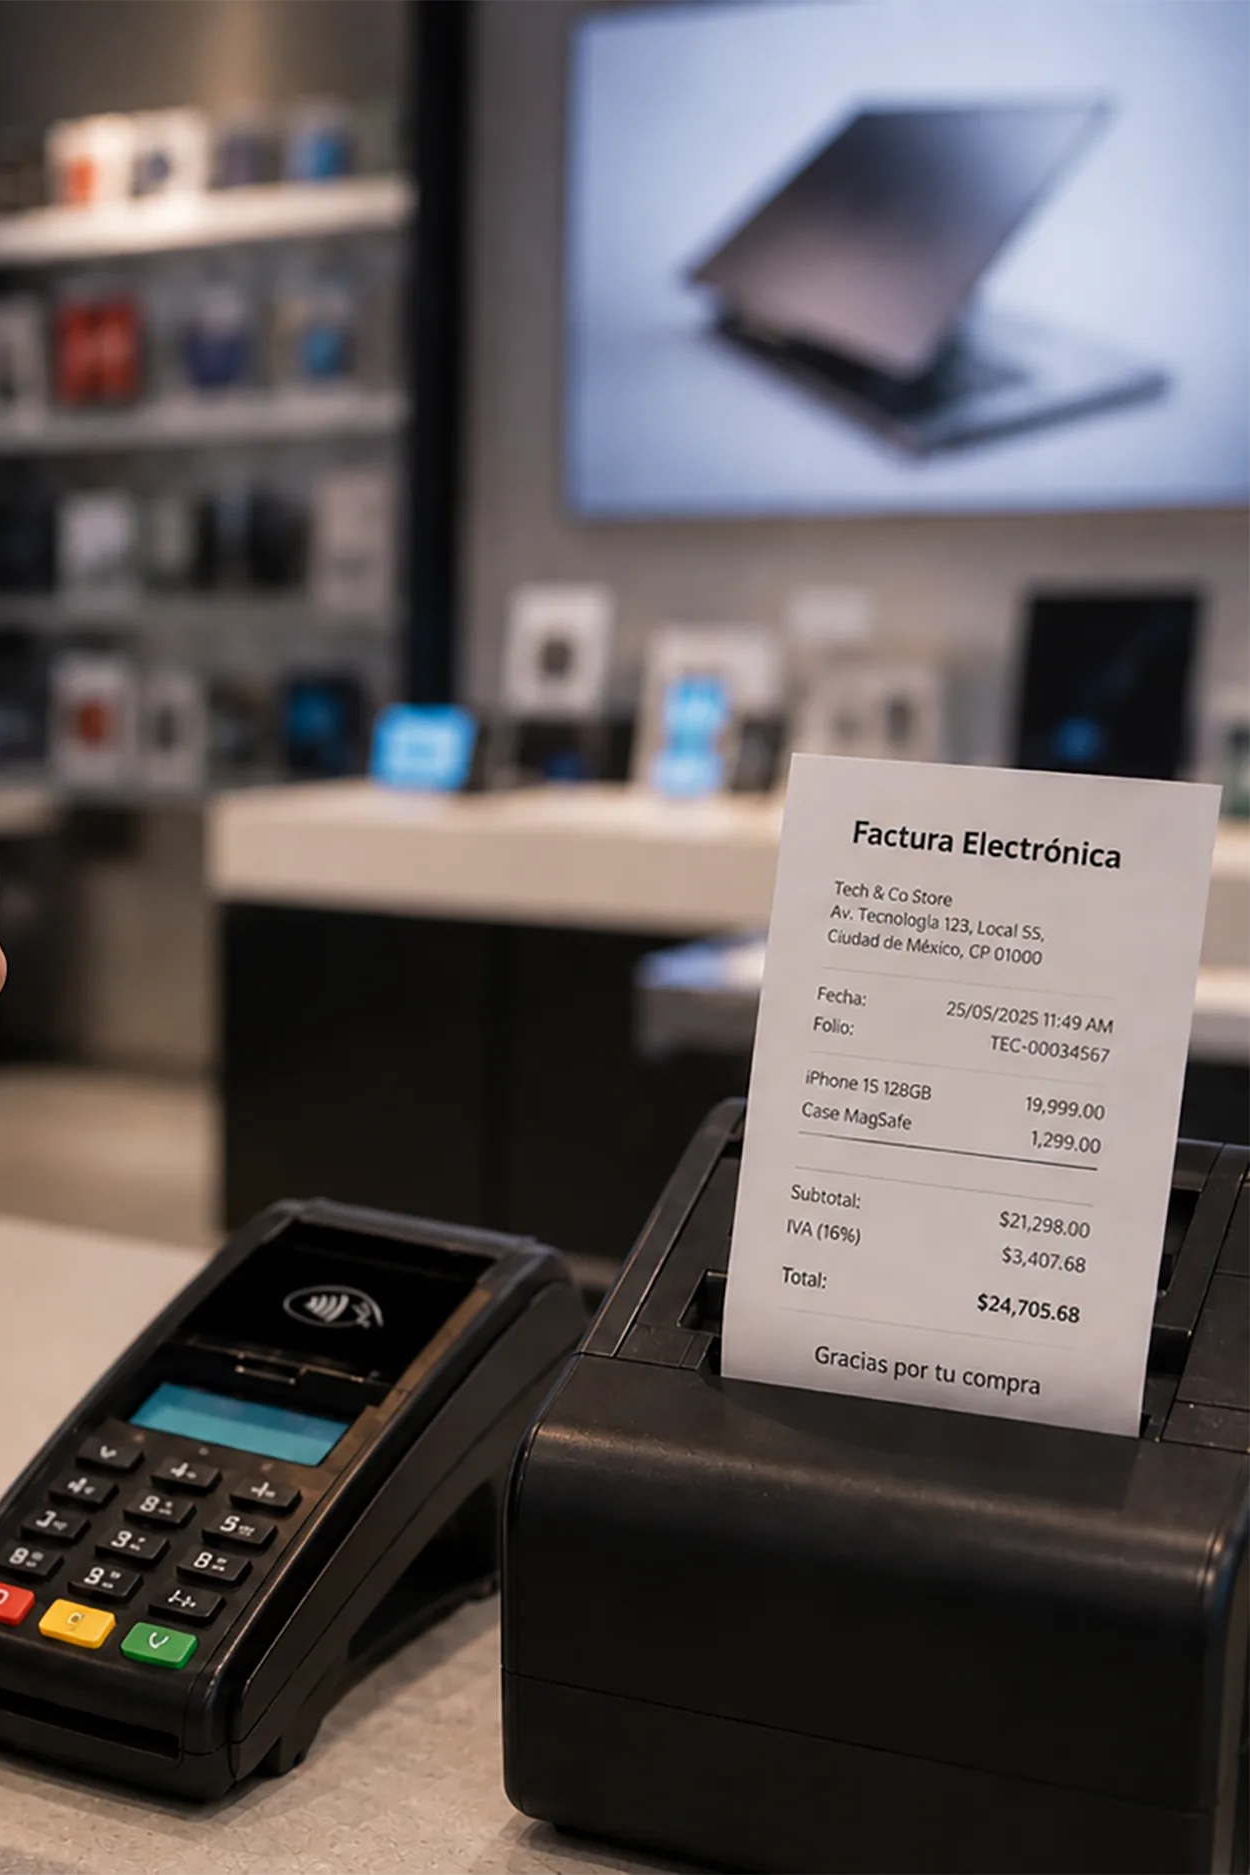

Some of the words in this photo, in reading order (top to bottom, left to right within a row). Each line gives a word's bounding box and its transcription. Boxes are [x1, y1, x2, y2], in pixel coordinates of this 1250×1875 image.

[852, 820, 954, 852] Factura
[962, 831, 1121, 869] Electrónica
[835, 880, 869, 898] Tech
[873, 885, 885, 900] &
[888, 887, 909, 902] Co
[912, 889, 953, 907] Store
[830, 905, 854, 921] Av.
[945, 917, 973, 936] 123,
[977, 921, 1018, 938] Local
[828, 929, 880, 948] Ciudad
[883, 936, 903, 951] de
[906, 938, 964, 959] México,
[969, 944, 990, 959] CP
[994, 947, 1043, 966] 01000
[817, 986, 867, 1007] Fecha:
[813, 1016, 855, 1036] Folio:
[947, 1001, 1039, 1026] 25/05/2025
[1043, 1012, 1082, 1031] 11:49
[1085, 1017, 1114, 1034] AM
[990, 1035, 1110, 1063] TEC-00034567
[805, 1070, 859, 1091] iPhone
[884, 1080, 932, 1101] 128GB
[801, 1101, 840, 1121] Case
[844, 1108, 912, 1131] MagSafe
[1026, 1096, 1105, 1121] 19,999.00
[1032, 1130, 1102, 1154] 1,299.00
[790, 1184, 861, 1209] Subtotal:
[786, 1219, 813, 1237] IVA
[817, 1222, 861, 1247] (16%)
[999, 1211, 1091, 1239] $21,298.00
[1002, 1246, 1086, 1274] $3,407.68
[782, 1266, 827, 1289] Total:
[977, 1292, 1080, 1324] $24,705.68
[814, 1345, 889, 1374] Gracias
[893, 1361, 929, 1380] por
[936, 1364, 956, 1383] tu
[962, 1370, 1041, 1396] compra
